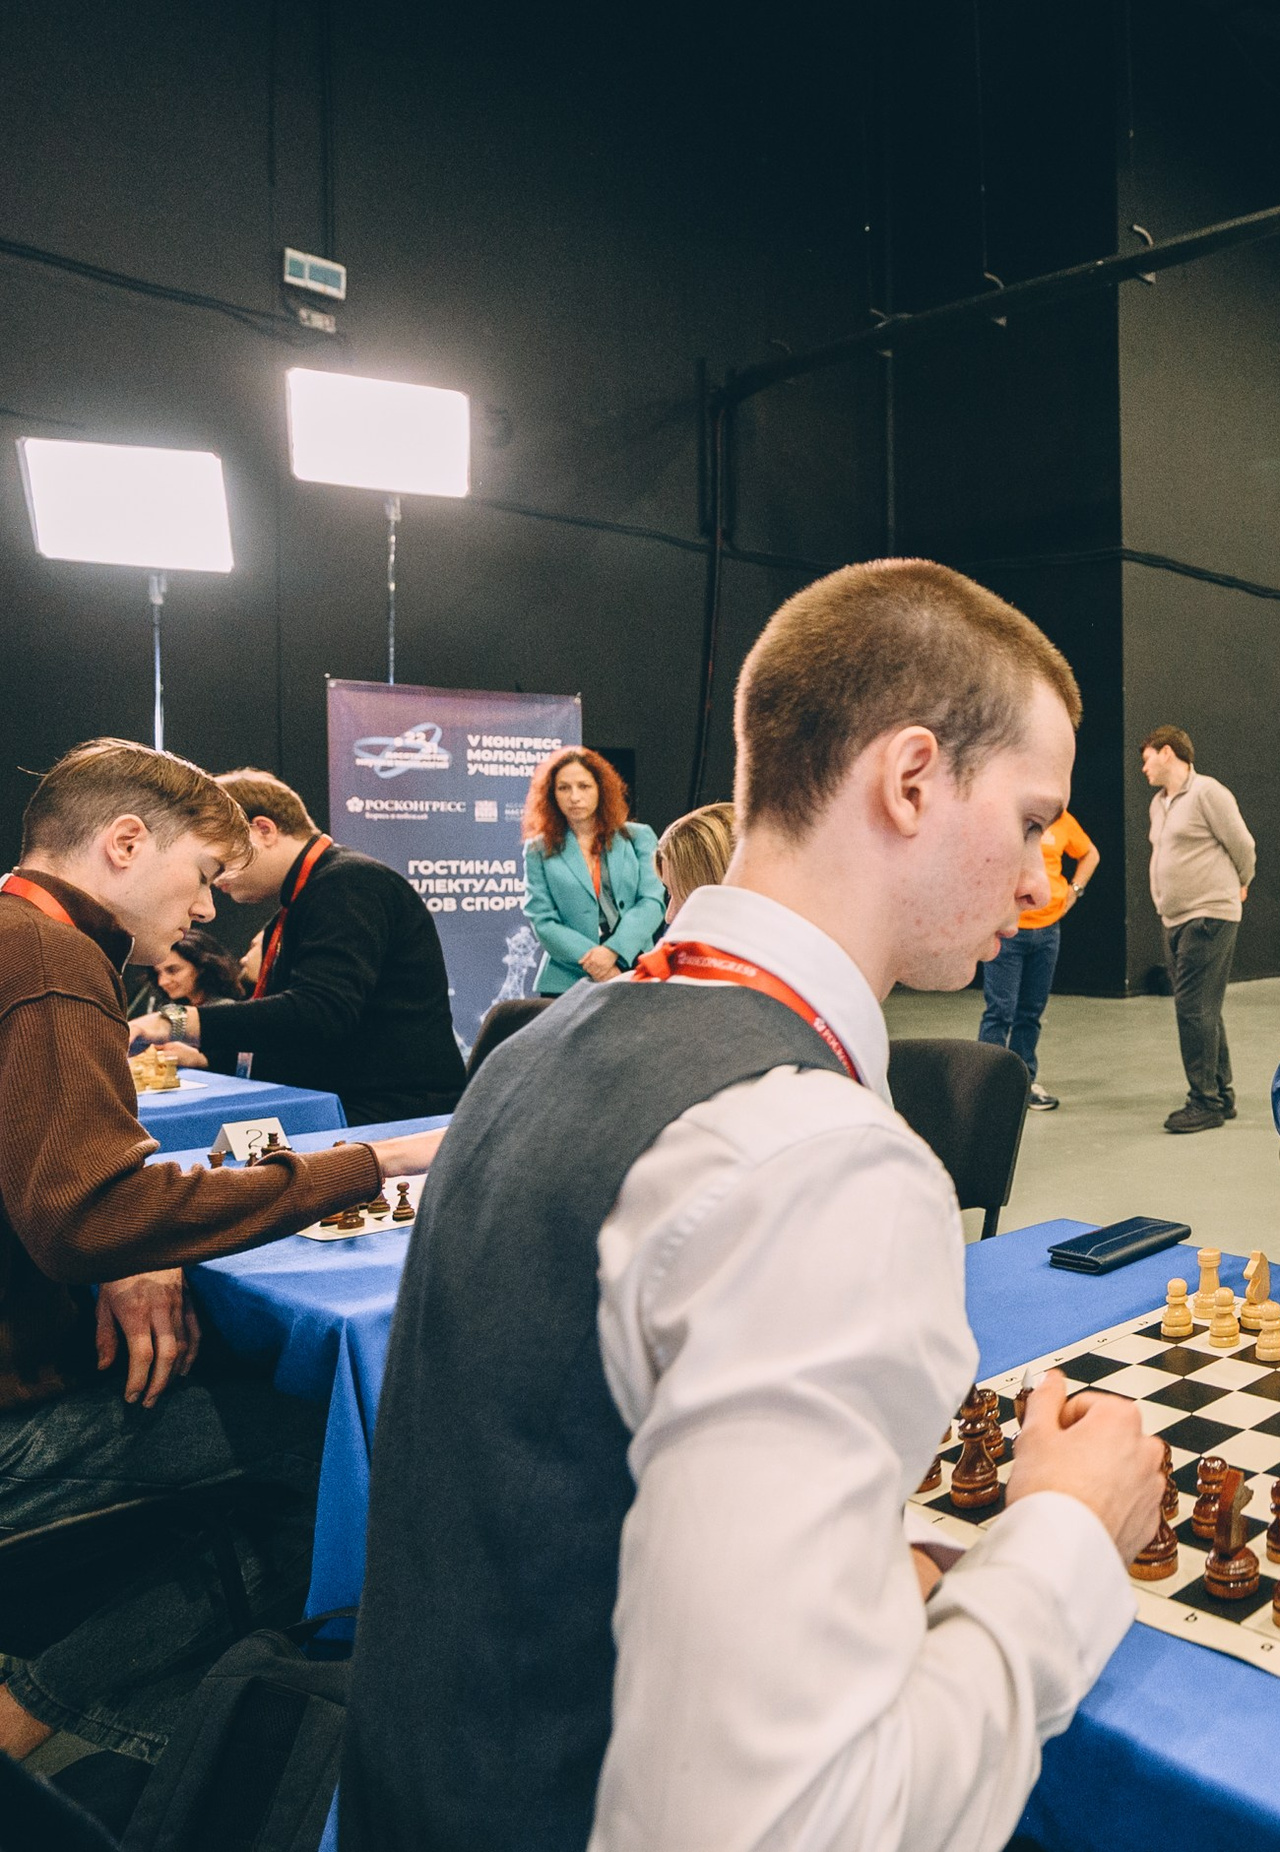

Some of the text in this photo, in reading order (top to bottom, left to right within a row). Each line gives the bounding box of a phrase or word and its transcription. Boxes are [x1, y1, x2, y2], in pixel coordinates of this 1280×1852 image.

[467, 734, 562, 751] V КОНГРЕСС
[467, 749, 550, 765] МОЛОДЫХ
[467, 763, 535, 777] УЧЕНЫХ
[365, 799, 466, 813] РОСКОНГРЕСС
[408, 860, 517, 876] ГОСТИНАЯ
[422, 897, 457, 912] ОВ
[246, 1129, 262, 1149] 2
